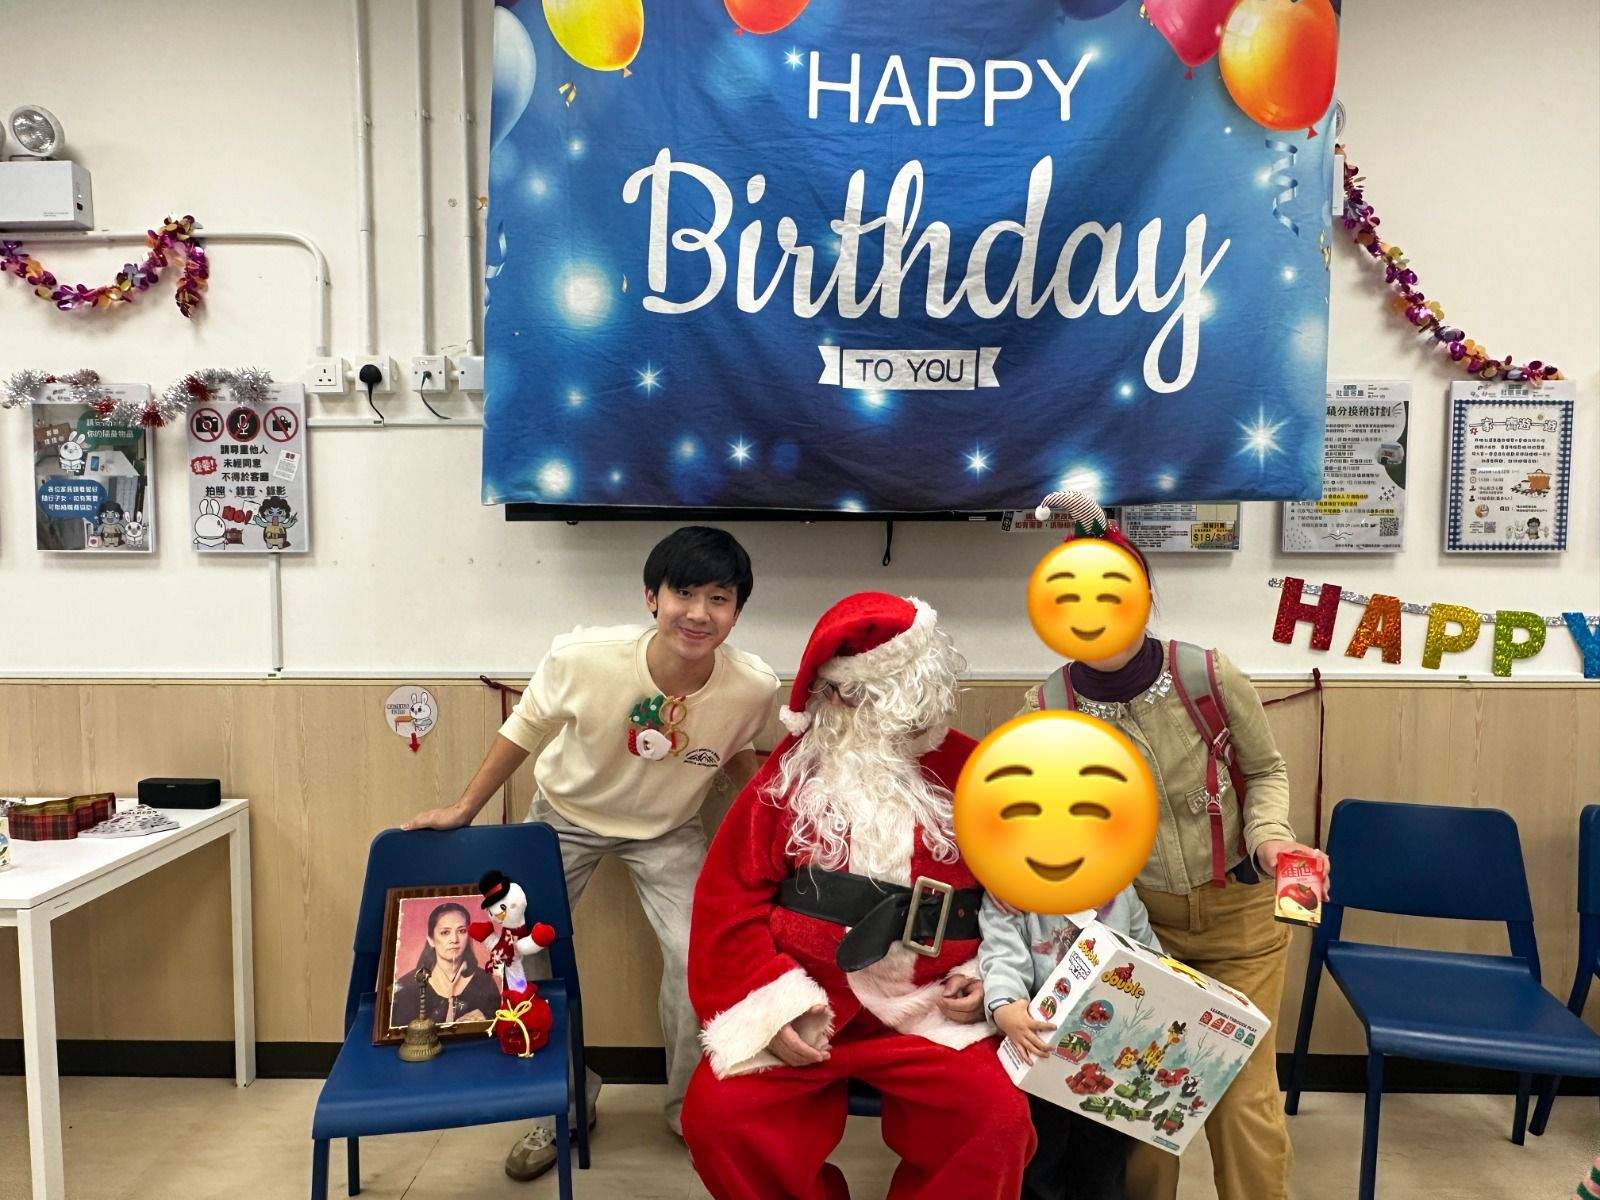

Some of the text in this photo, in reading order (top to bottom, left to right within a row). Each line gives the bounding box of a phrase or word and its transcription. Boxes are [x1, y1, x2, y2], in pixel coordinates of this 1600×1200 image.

[808, 51, 1095, 127] HAPPY
[622, 147, 1231, 394] Birthday
[855, 358, 964, 384] TO YOU
[220, 444, 269, 455] 請尊重他人
[223, 458, 262, 469] 未經同意
[1273, 576, 1600, 679] HAPPY
